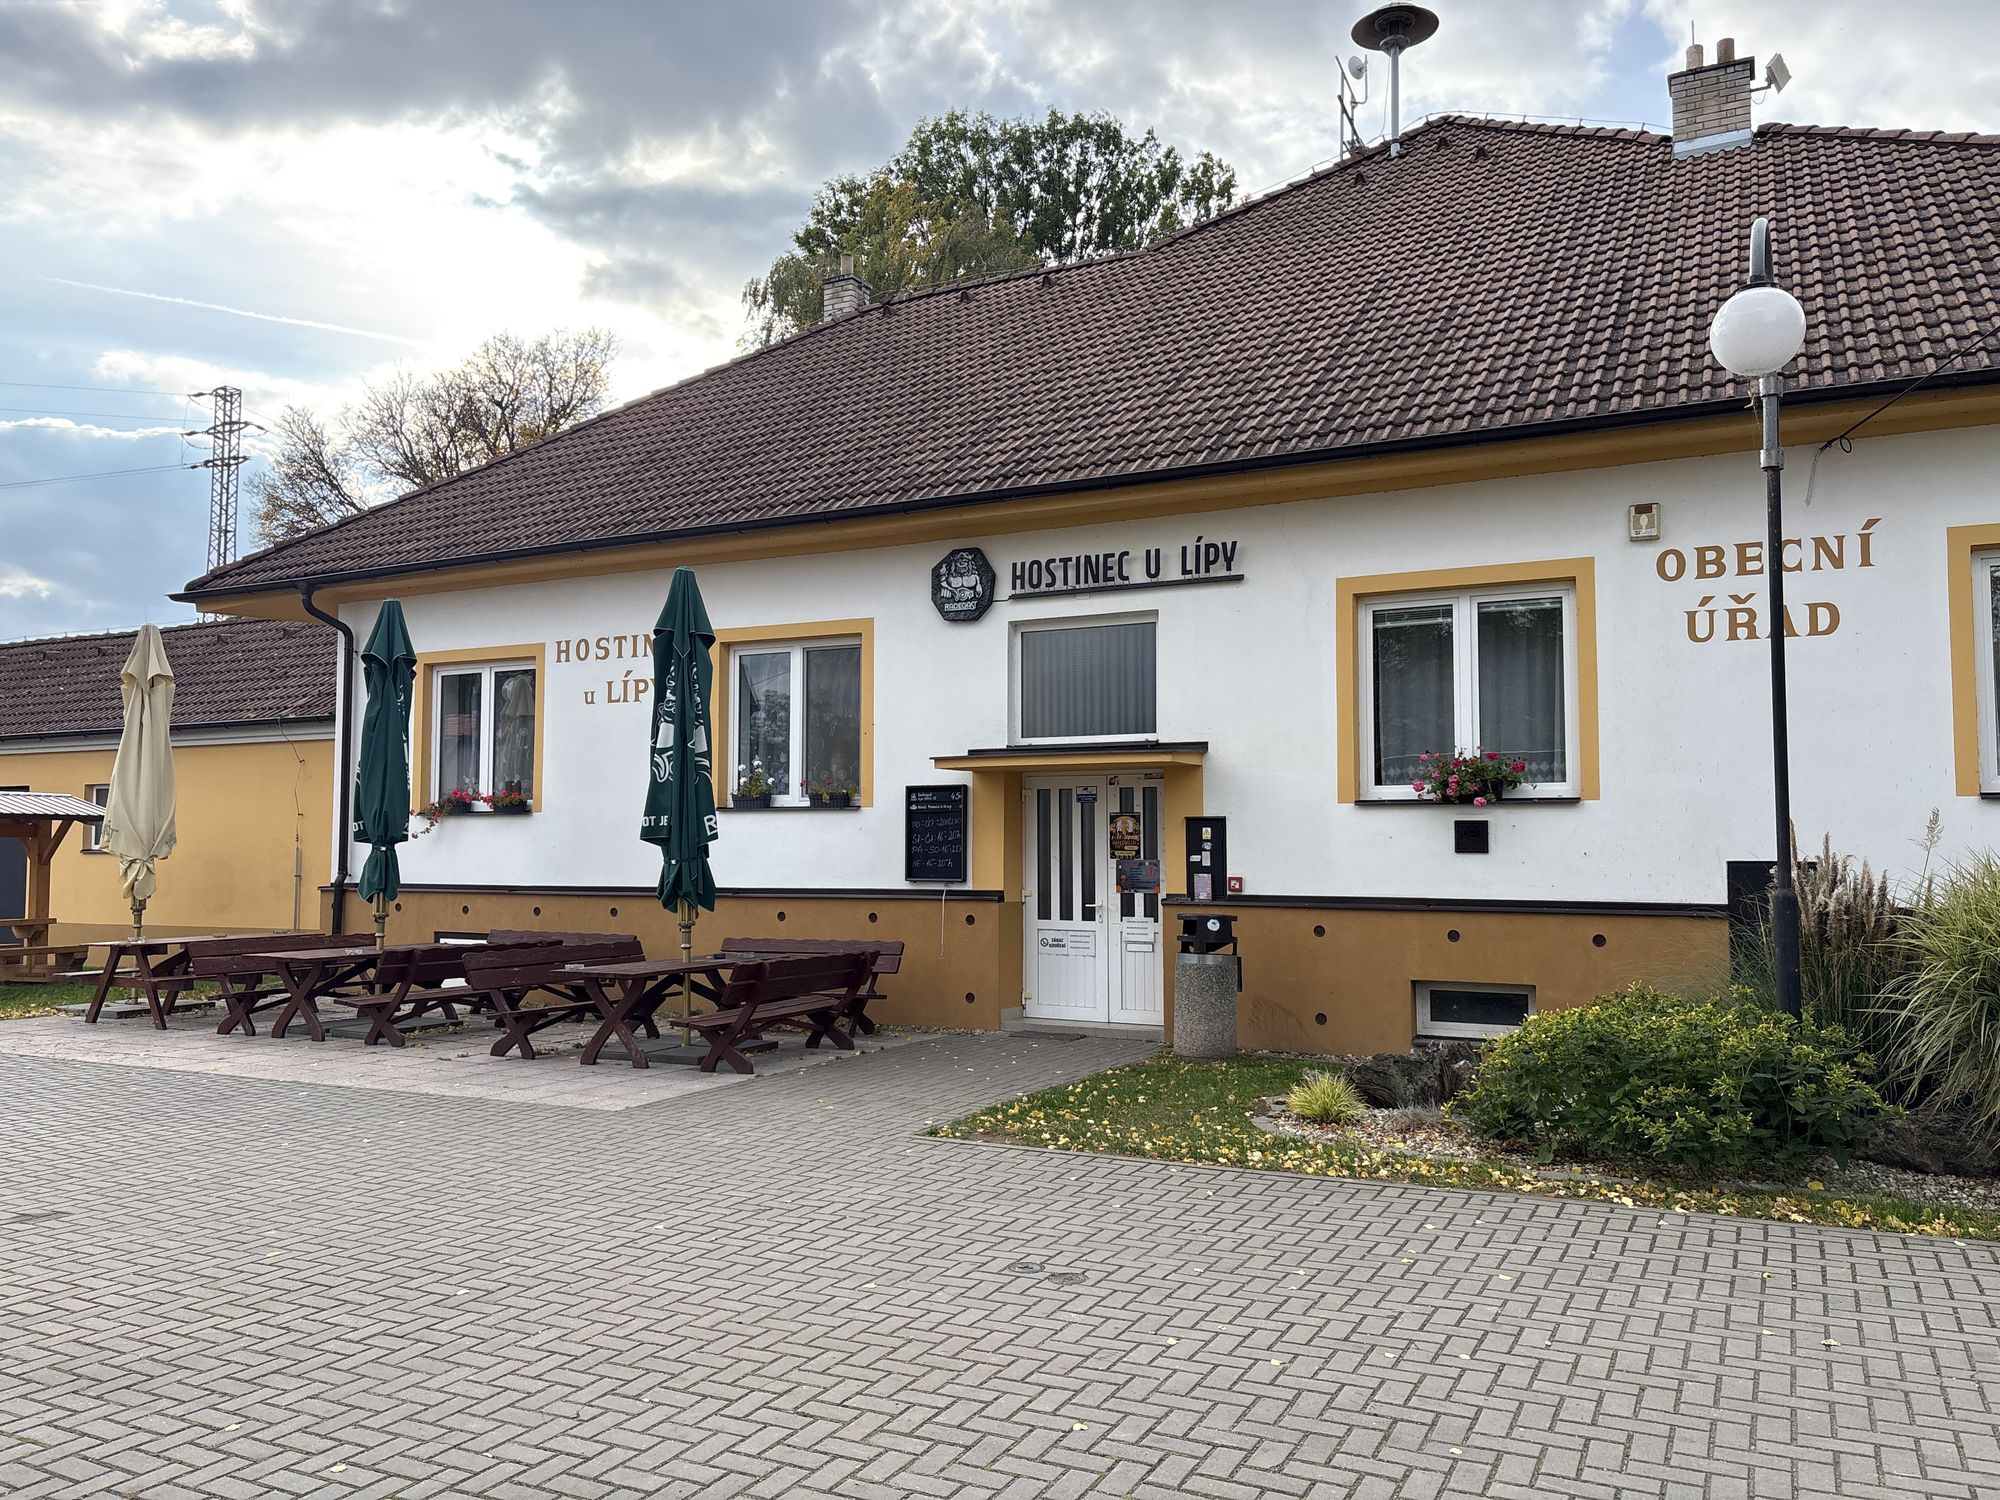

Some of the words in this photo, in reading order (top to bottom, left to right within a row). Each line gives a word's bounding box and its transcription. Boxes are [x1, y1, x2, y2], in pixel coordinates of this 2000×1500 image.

[1011, 550, 1130, 590] HOSTINEC
[1145, 548, 1161, 579] U
[1181, 536, 1238, 576] LÍPY
[1655, 517, 1883, 582] OBECNÍ
[944, 601, 977, 611] RADEGAST
[1683, 592, 1841, 643] ÚŘAD
[584, 690, 596, 705] u
[606, 669, 655, 704] LÍP
